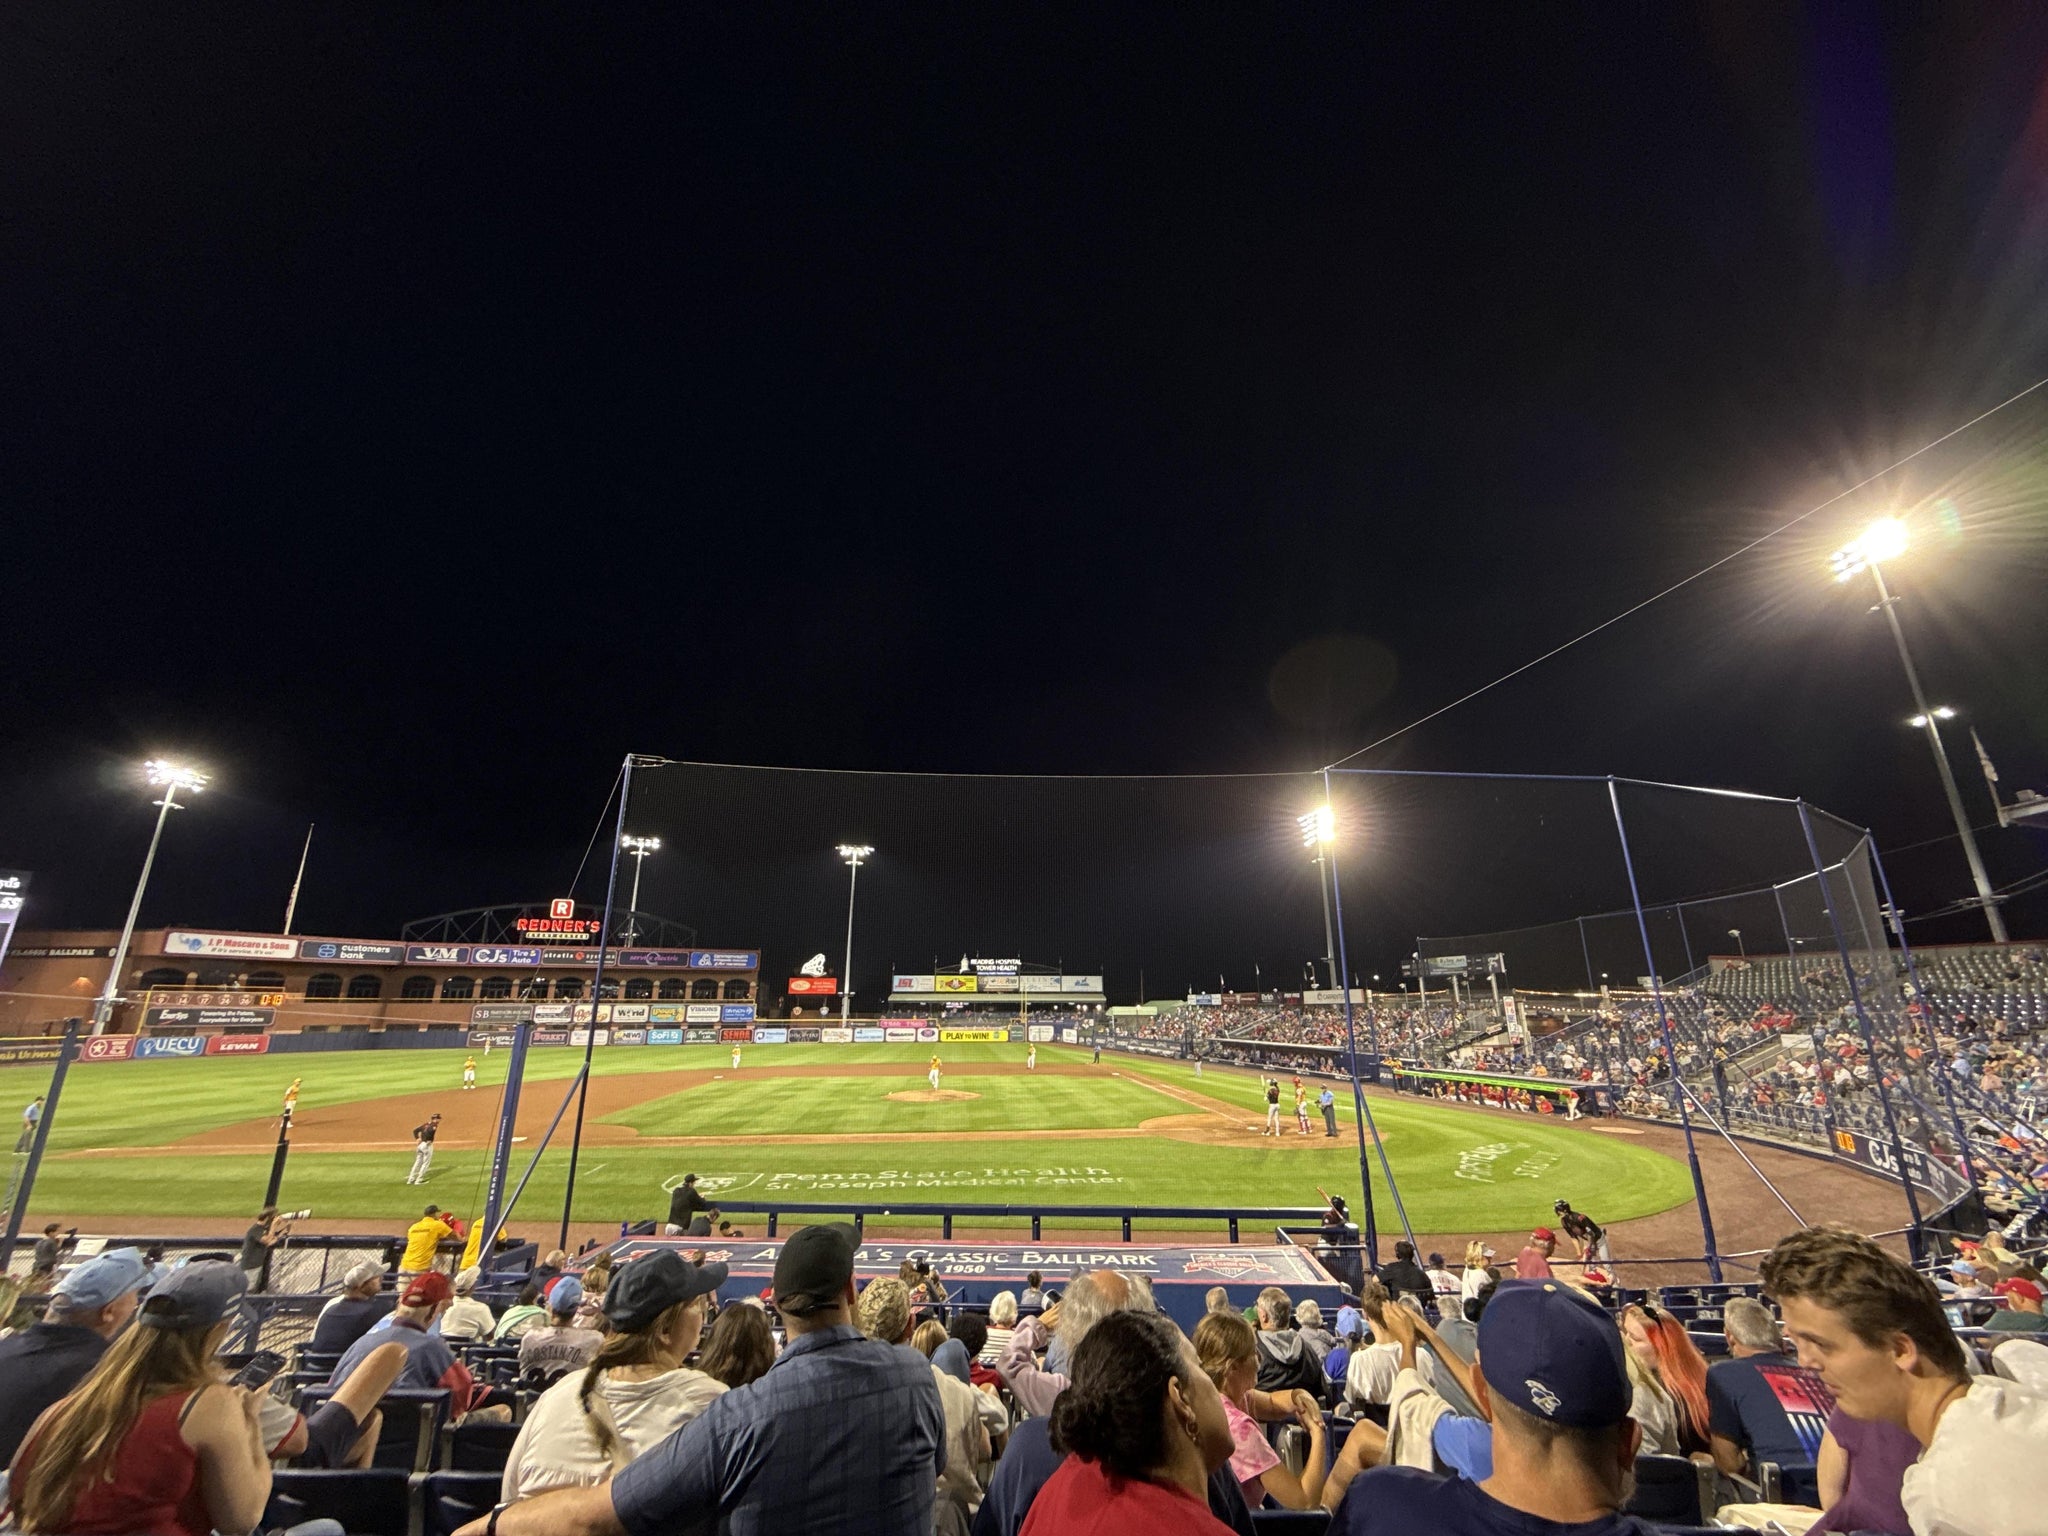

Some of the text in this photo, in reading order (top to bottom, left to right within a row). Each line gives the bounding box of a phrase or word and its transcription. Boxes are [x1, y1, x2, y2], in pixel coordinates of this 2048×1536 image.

[517, 919, 600, 933] REDNER'S
[224, 939, 261, 948] Mascaro
[270, 942, 290, 950] Sons
[341, 945, 390, 953] customers
[475, 949, 507, 963] CJs
[155, 1038, 200, 1050] UECU
[1868, 1140, 1900, 1173] CJs
[983, 1167, 1110, 1177] Health
[807, 1181, 906, 1190] Joseph
[916, 1178, 1026, 1188] Medical
[1035, 1177, 1125, 1185] Center
[906, 1250, 1010, 1263] CLASSIC
[1022, 1251, 1157, 1265] BALLPARK
[944, 1264, 986, 1273] 1950
